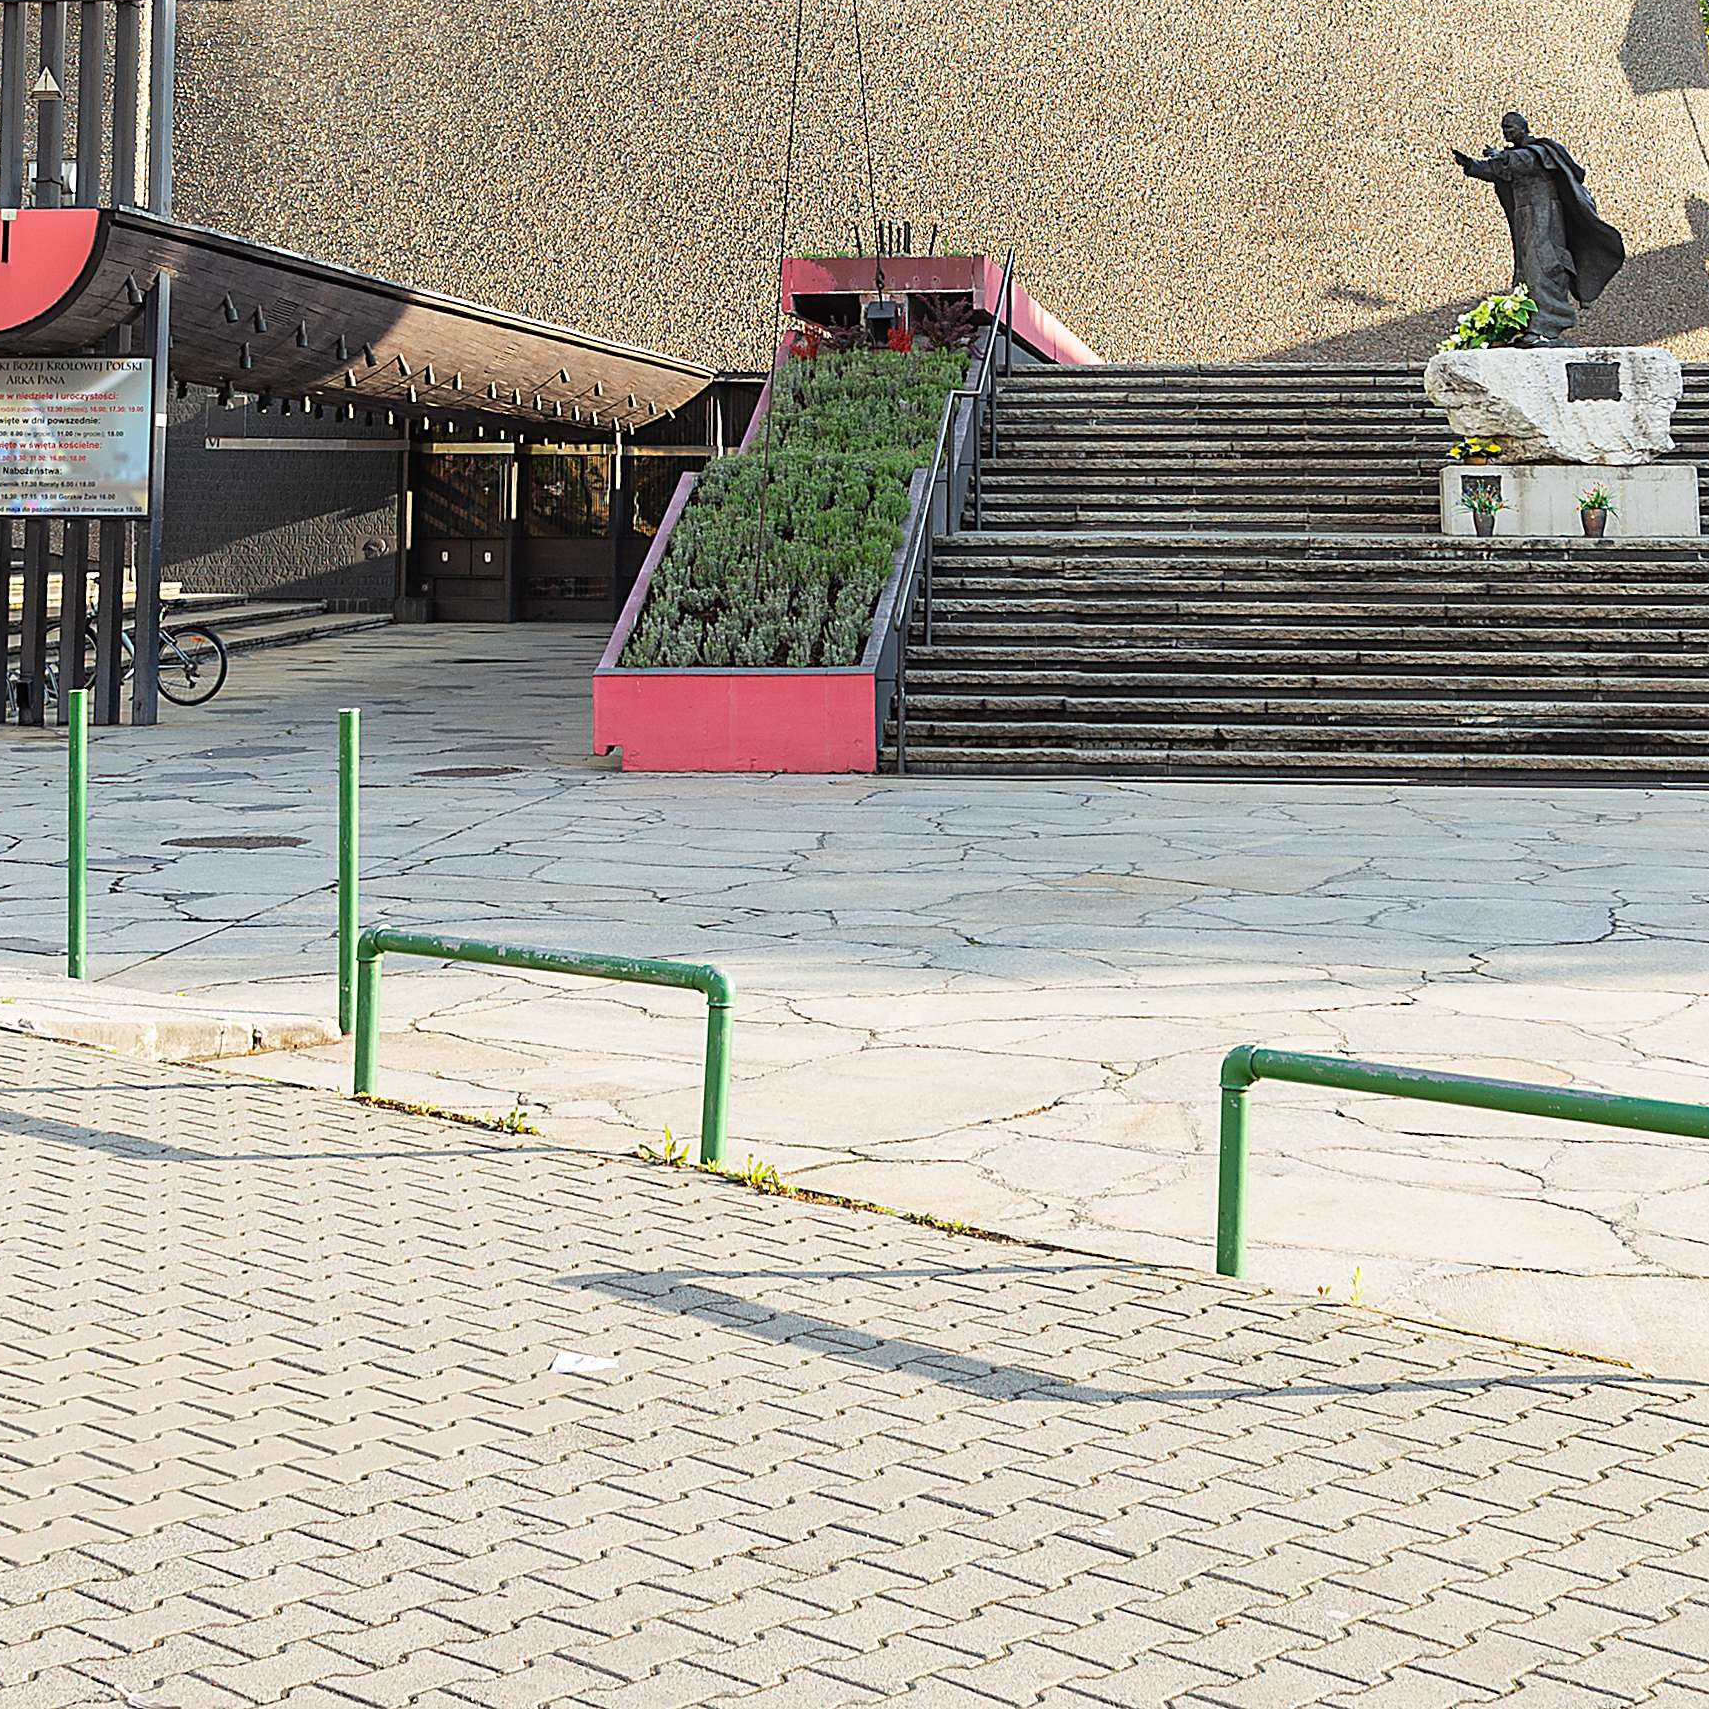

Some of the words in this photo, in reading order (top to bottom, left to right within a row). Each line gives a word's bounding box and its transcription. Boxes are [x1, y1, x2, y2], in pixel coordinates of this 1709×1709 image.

[106, 361, 142, 372] POLSKI
[6, 375, 34, 385] ARKA
[38, 375, 65, 385] PANA
[16, 392, 53, 401] niedziele
[61, 392, 119, 401] uroczystości:
[32, 416, 44, 424] dni
[47, 416, 100, 424] powszednie:
[29, 441, 56, 449] święta
[58, 441, 102, 449] kościelne:
[2, 467, 62, 475] Nabożeństwa:
